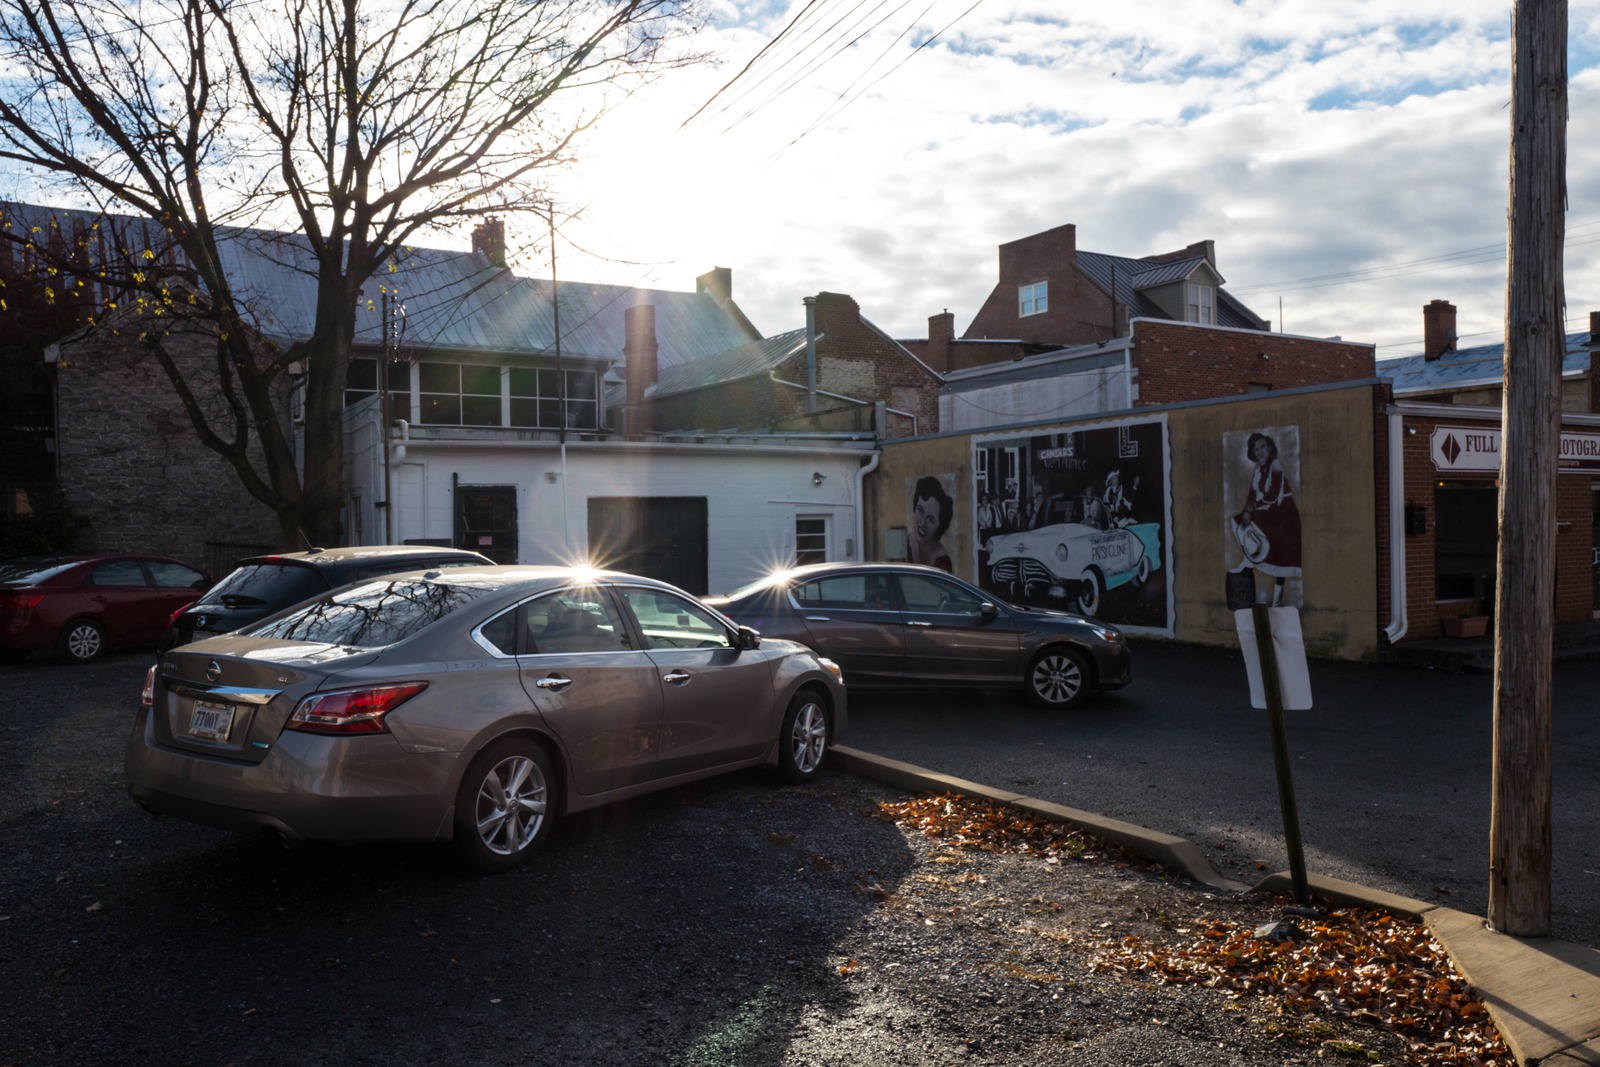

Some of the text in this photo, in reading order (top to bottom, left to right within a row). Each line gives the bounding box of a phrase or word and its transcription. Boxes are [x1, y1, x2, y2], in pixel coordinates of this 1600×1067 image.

[1465, 434, 1600, 456] FULL OTOGR
[1091, 542, 1129, 562] PATSY CLINE
